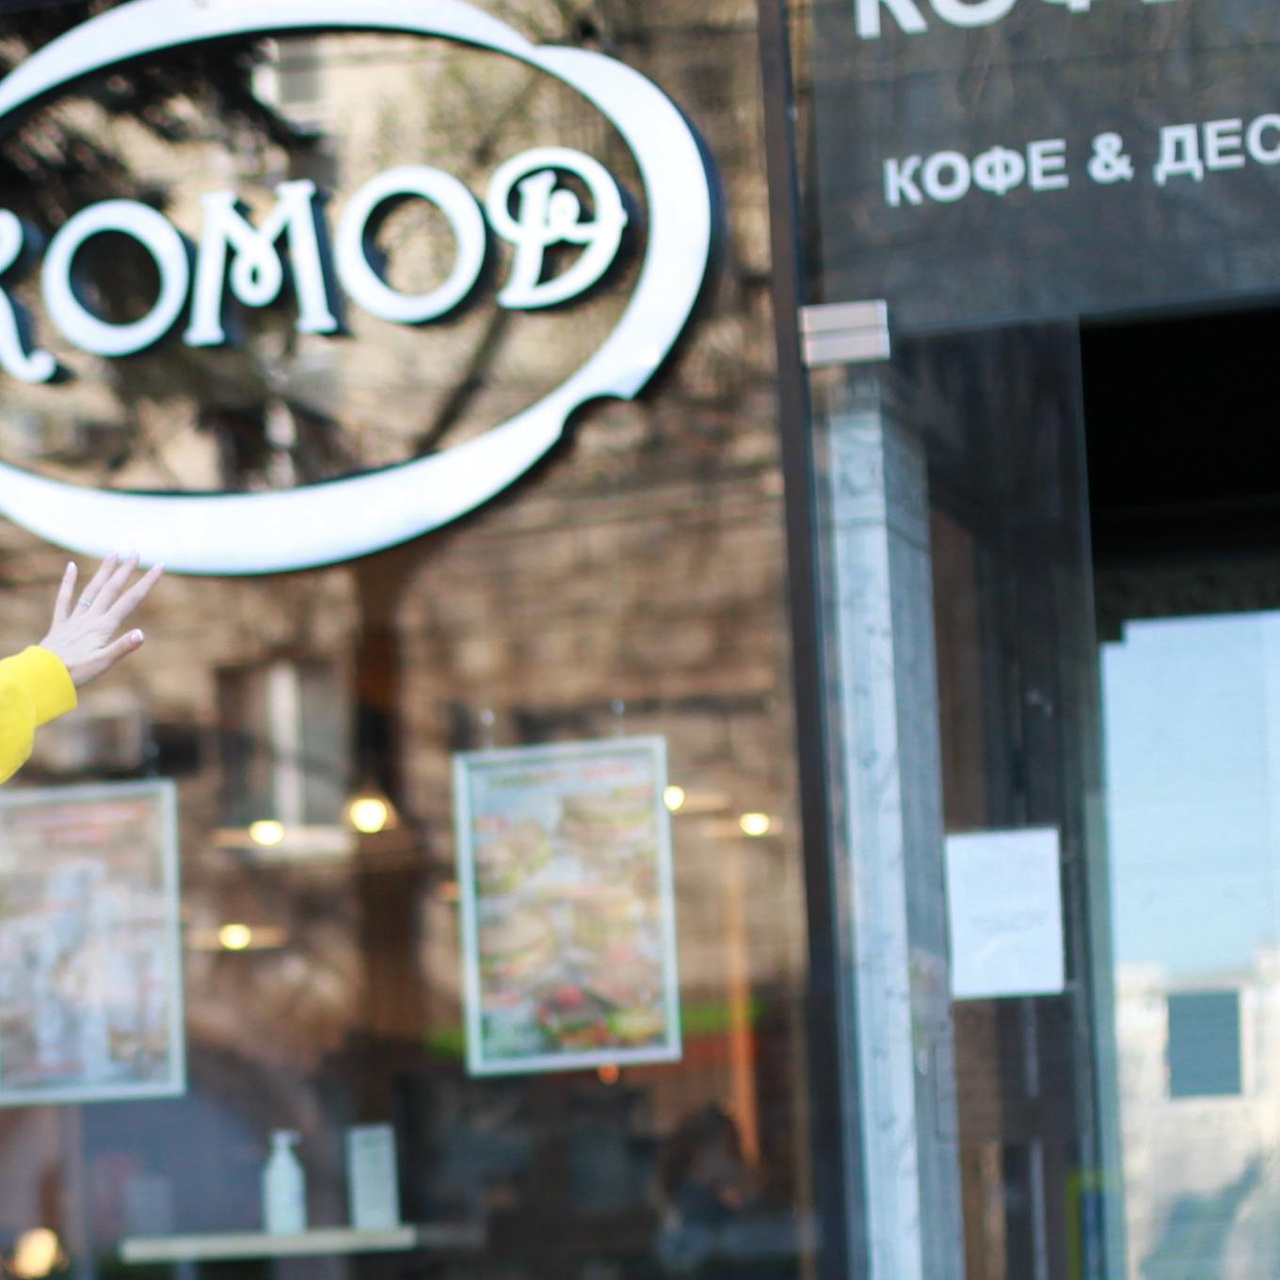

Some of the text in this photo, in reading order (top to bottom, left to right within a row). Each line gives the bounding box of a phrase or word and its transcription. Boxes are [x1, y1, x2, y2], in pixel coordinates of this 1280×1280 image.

[883, 112, 1280, 208] КОФЕ & ДЕС
